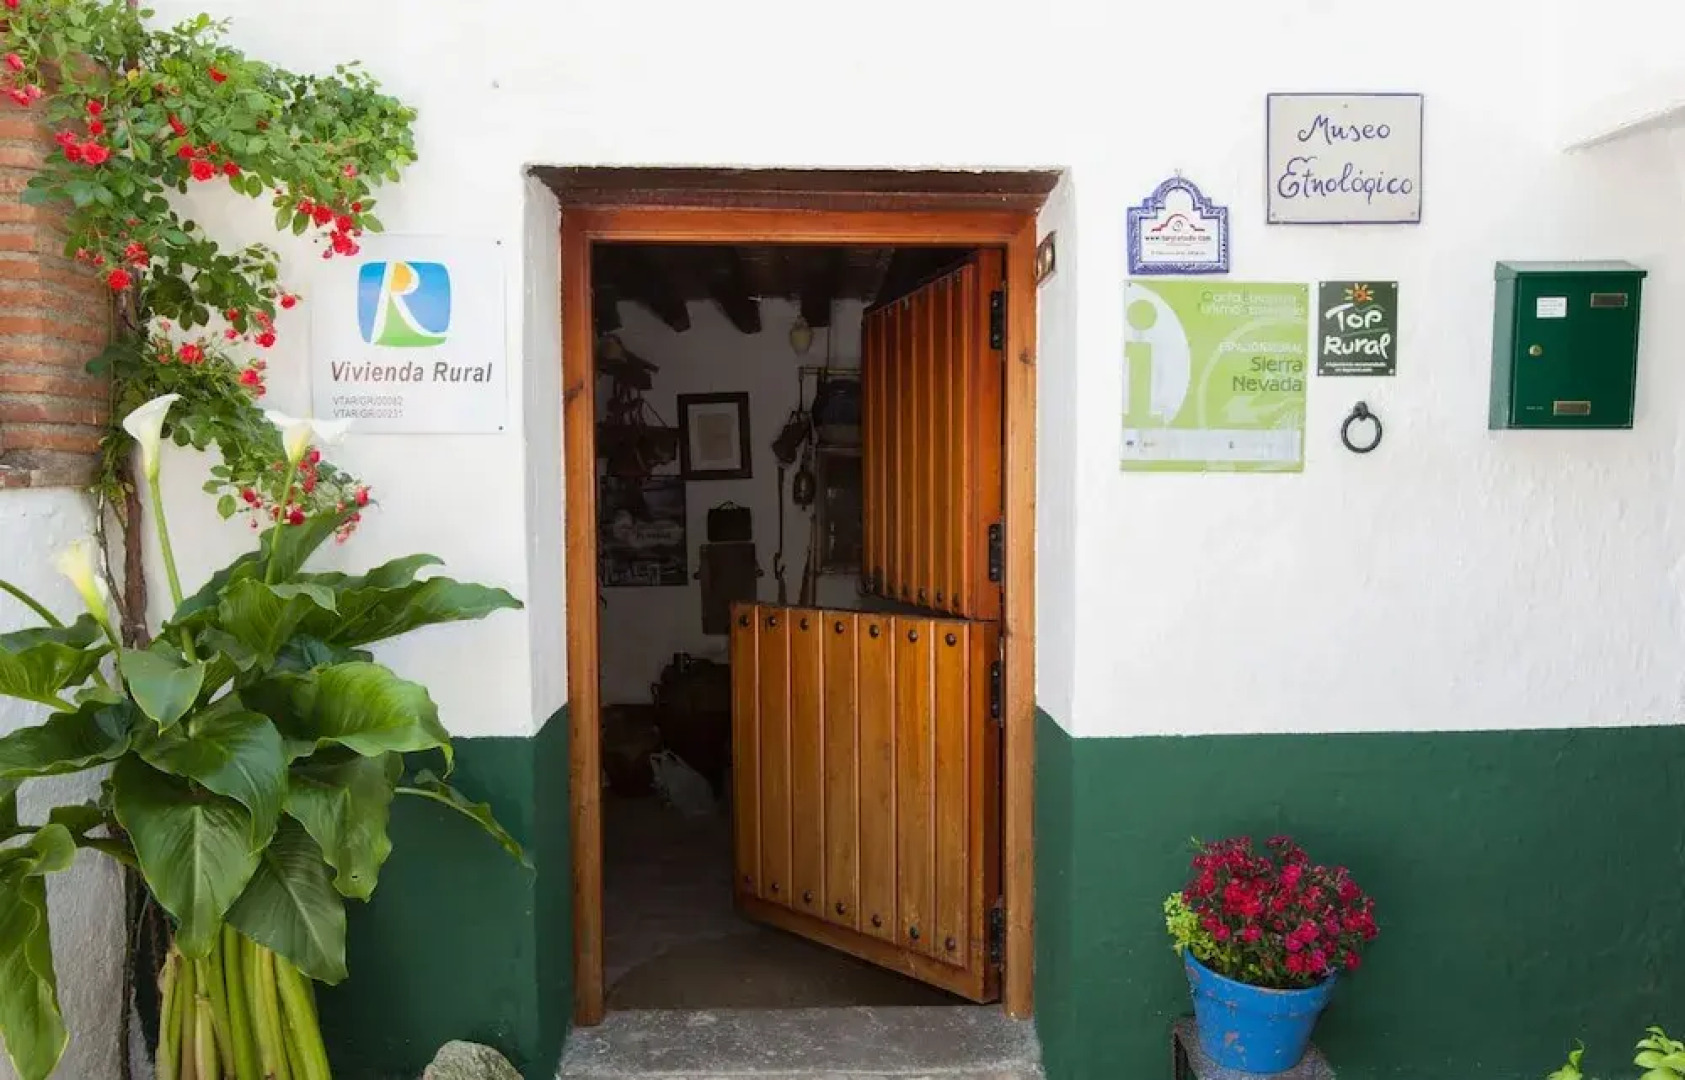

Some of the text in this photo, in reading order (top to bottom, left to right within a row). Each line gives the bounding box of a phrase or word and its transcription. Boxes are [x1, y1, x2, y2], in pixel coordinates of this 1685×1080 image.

[1297, 114, 1391, 145] Museo
[1277, 156, 1413, 205] Etnológico
[1323, 333, 1391, 359] Rural
[331, 361, 493, 382] Vivienda Rural
[1250, 356, 1303, 372] Sierra
[1232, 375, 1303, 392] Nevada
